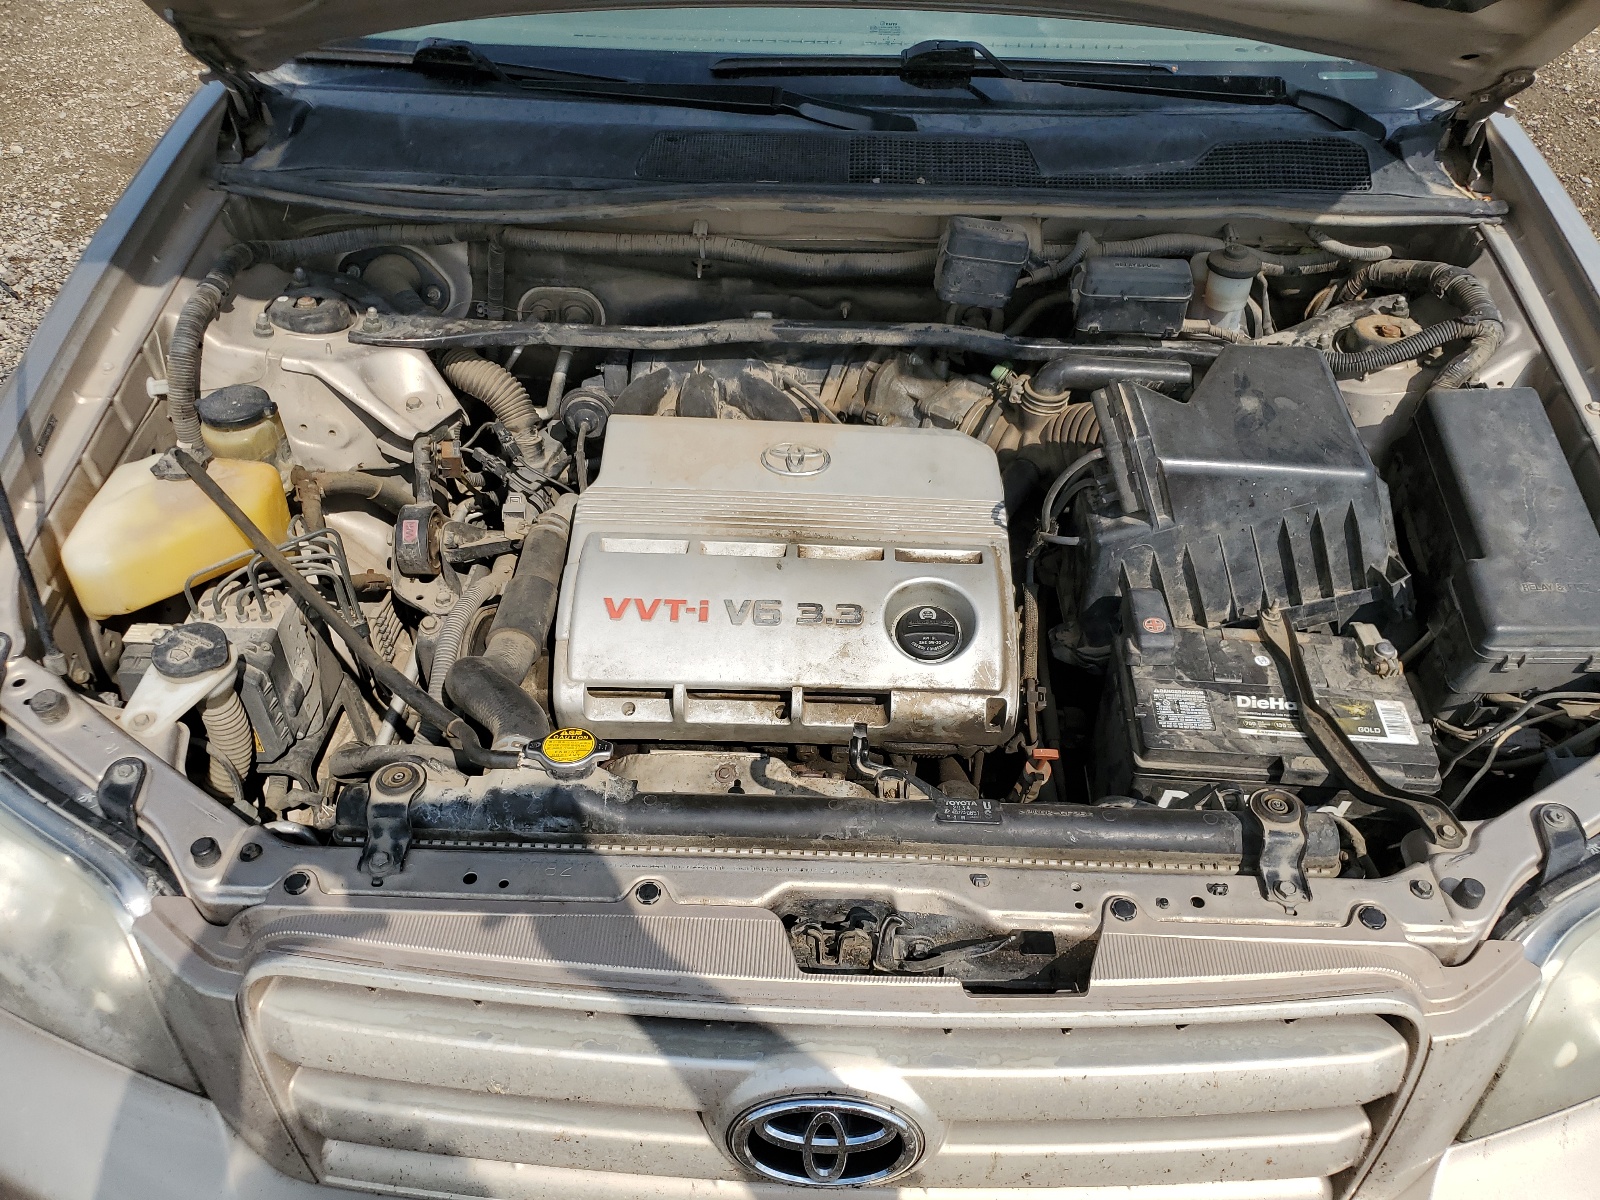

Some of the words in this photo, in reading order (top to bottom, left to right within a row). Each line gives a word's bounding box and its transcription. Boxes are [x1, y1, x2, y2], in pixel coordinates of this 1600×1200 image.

[1521, 583, 1553, 592] RELAY
[603, 597, 709, 622] VVT-i
[724, 599, 782, 626] V6
[796, 602, 864, 626] 3.3
[1236, 695, 1298, 711] DieHa
[1357, 726, 1381, 734] GOLD
